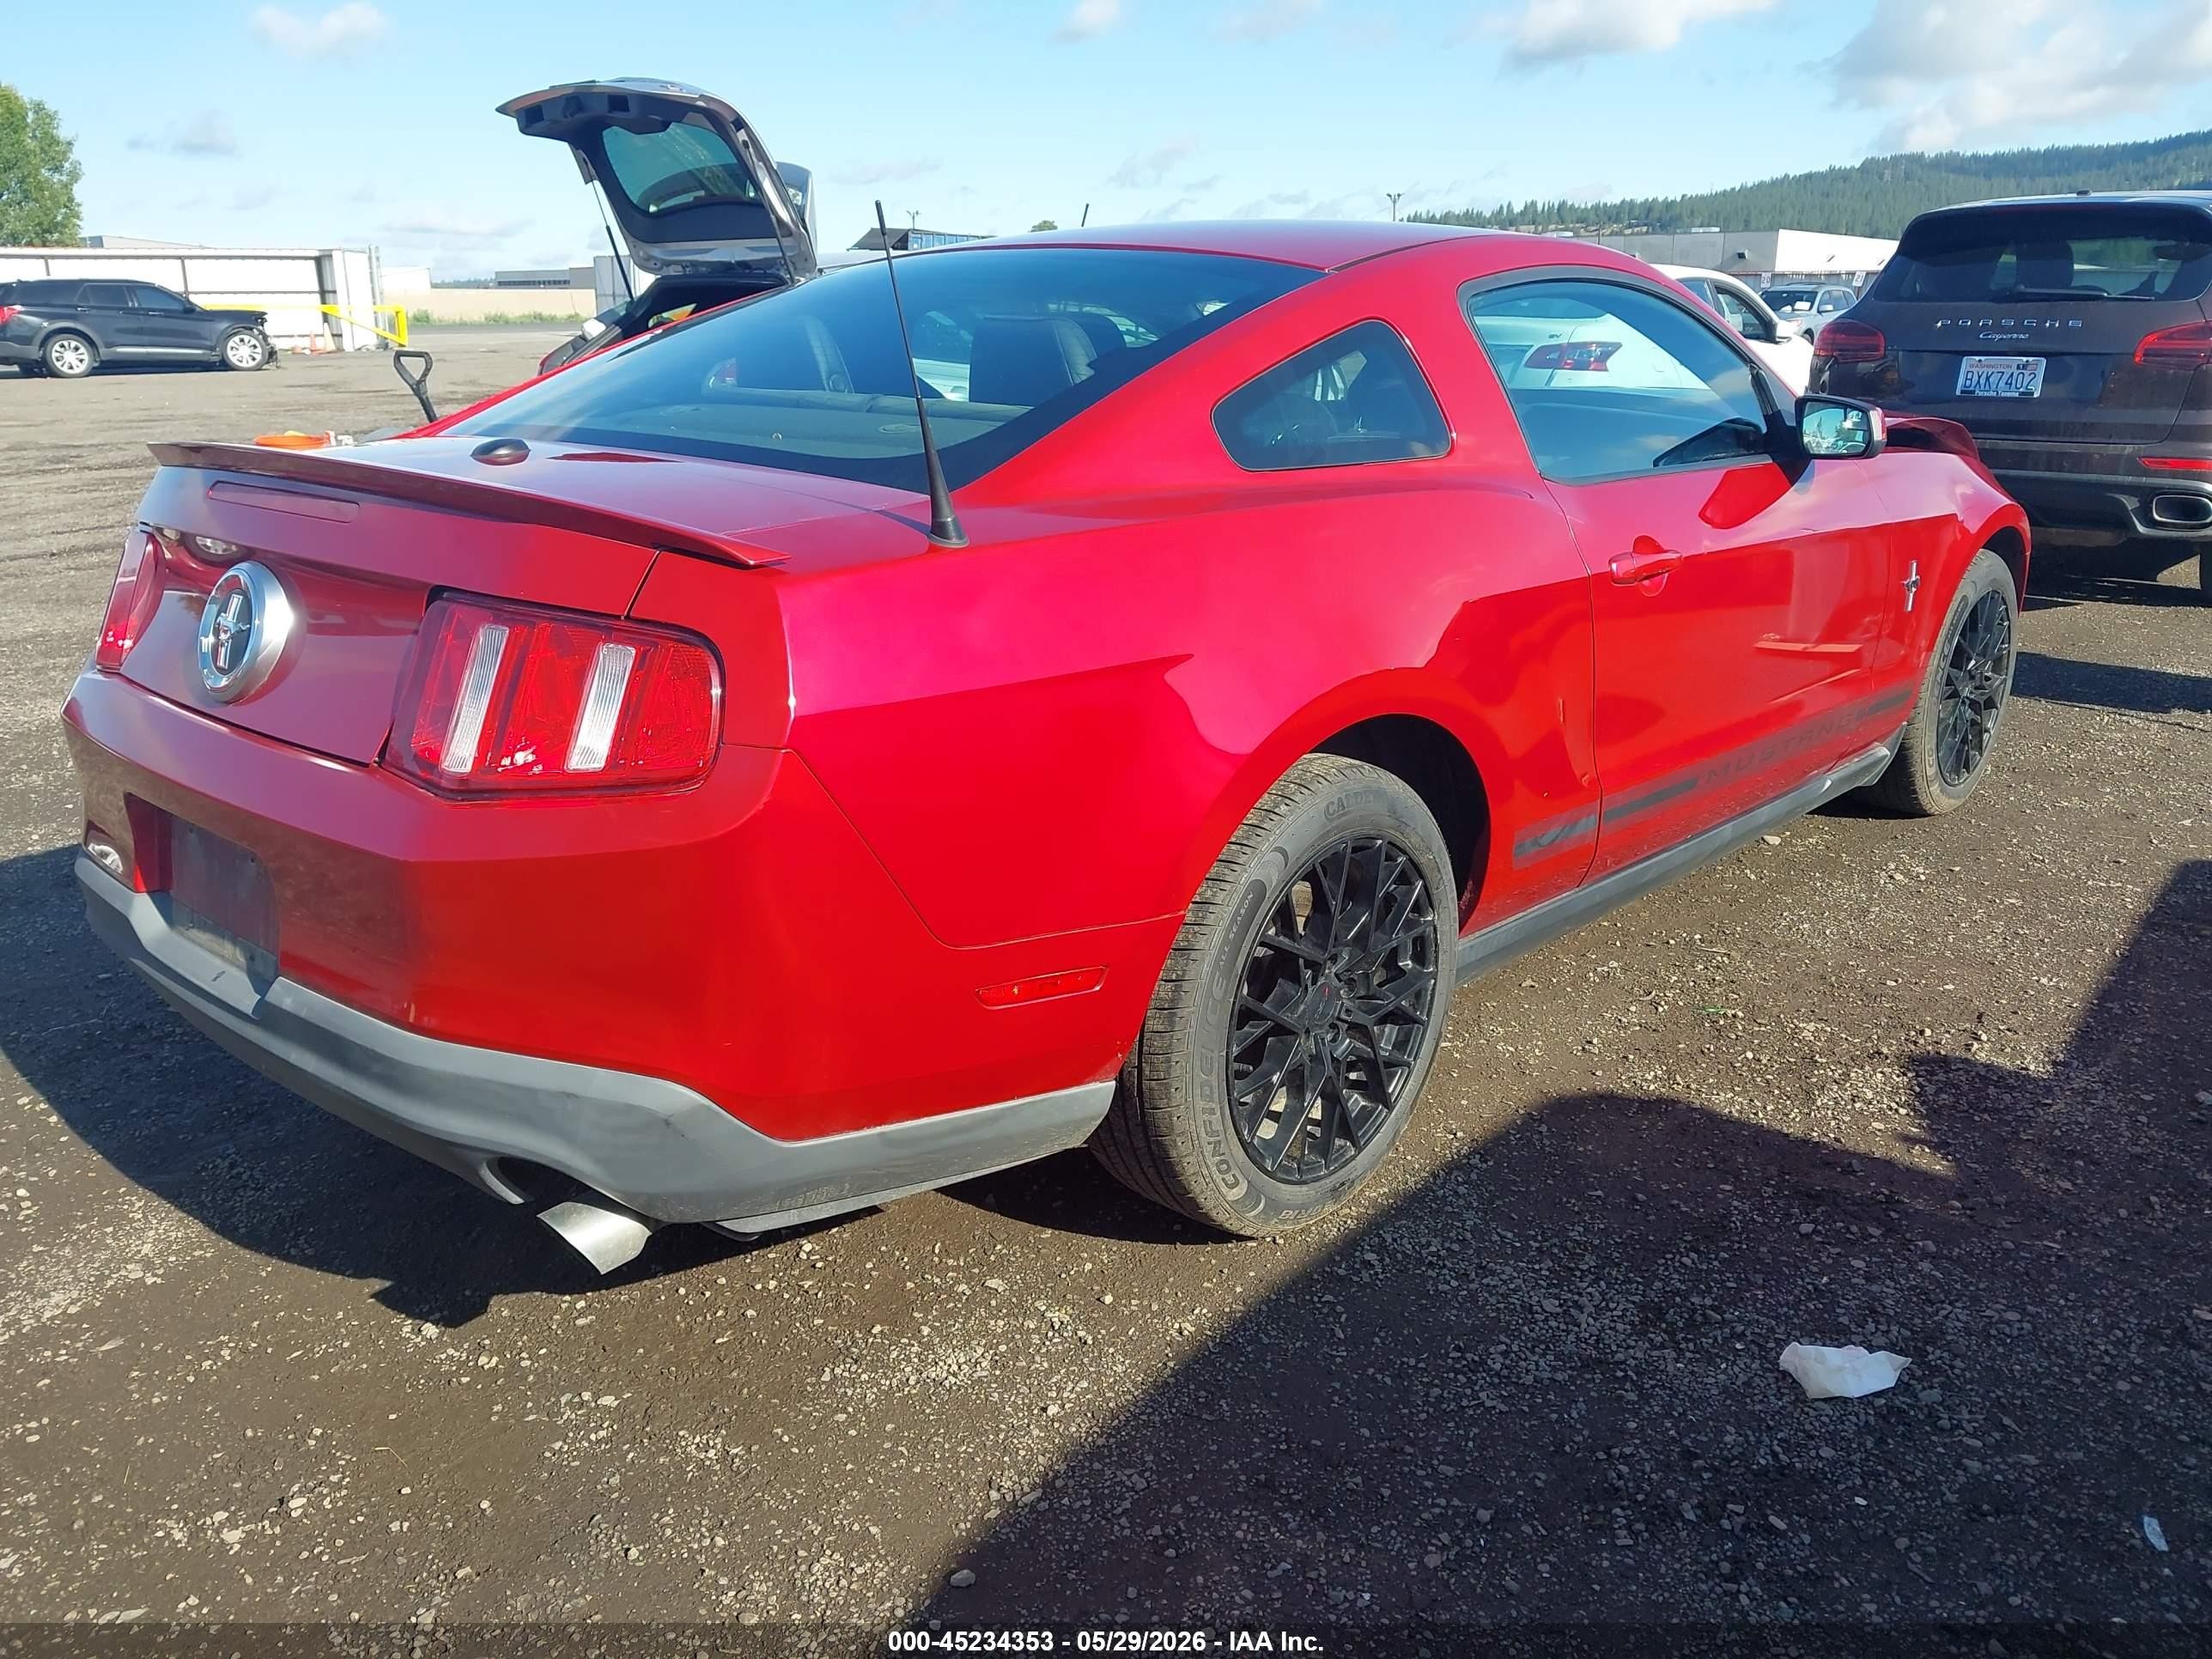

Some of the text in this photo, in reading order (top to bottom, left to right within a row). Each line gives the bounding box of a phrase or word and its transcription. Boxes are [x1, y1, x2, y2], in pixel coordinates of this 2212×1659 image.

[1761, 275, 1770, 284] 20
[1936, 319, 2083, 329] PORSCHE
[1978, 331, 2030, 342] Cayenne
[1964, 371, 2036, 391] BXK7402
[1228, 890, 1255, 942] SEASON
